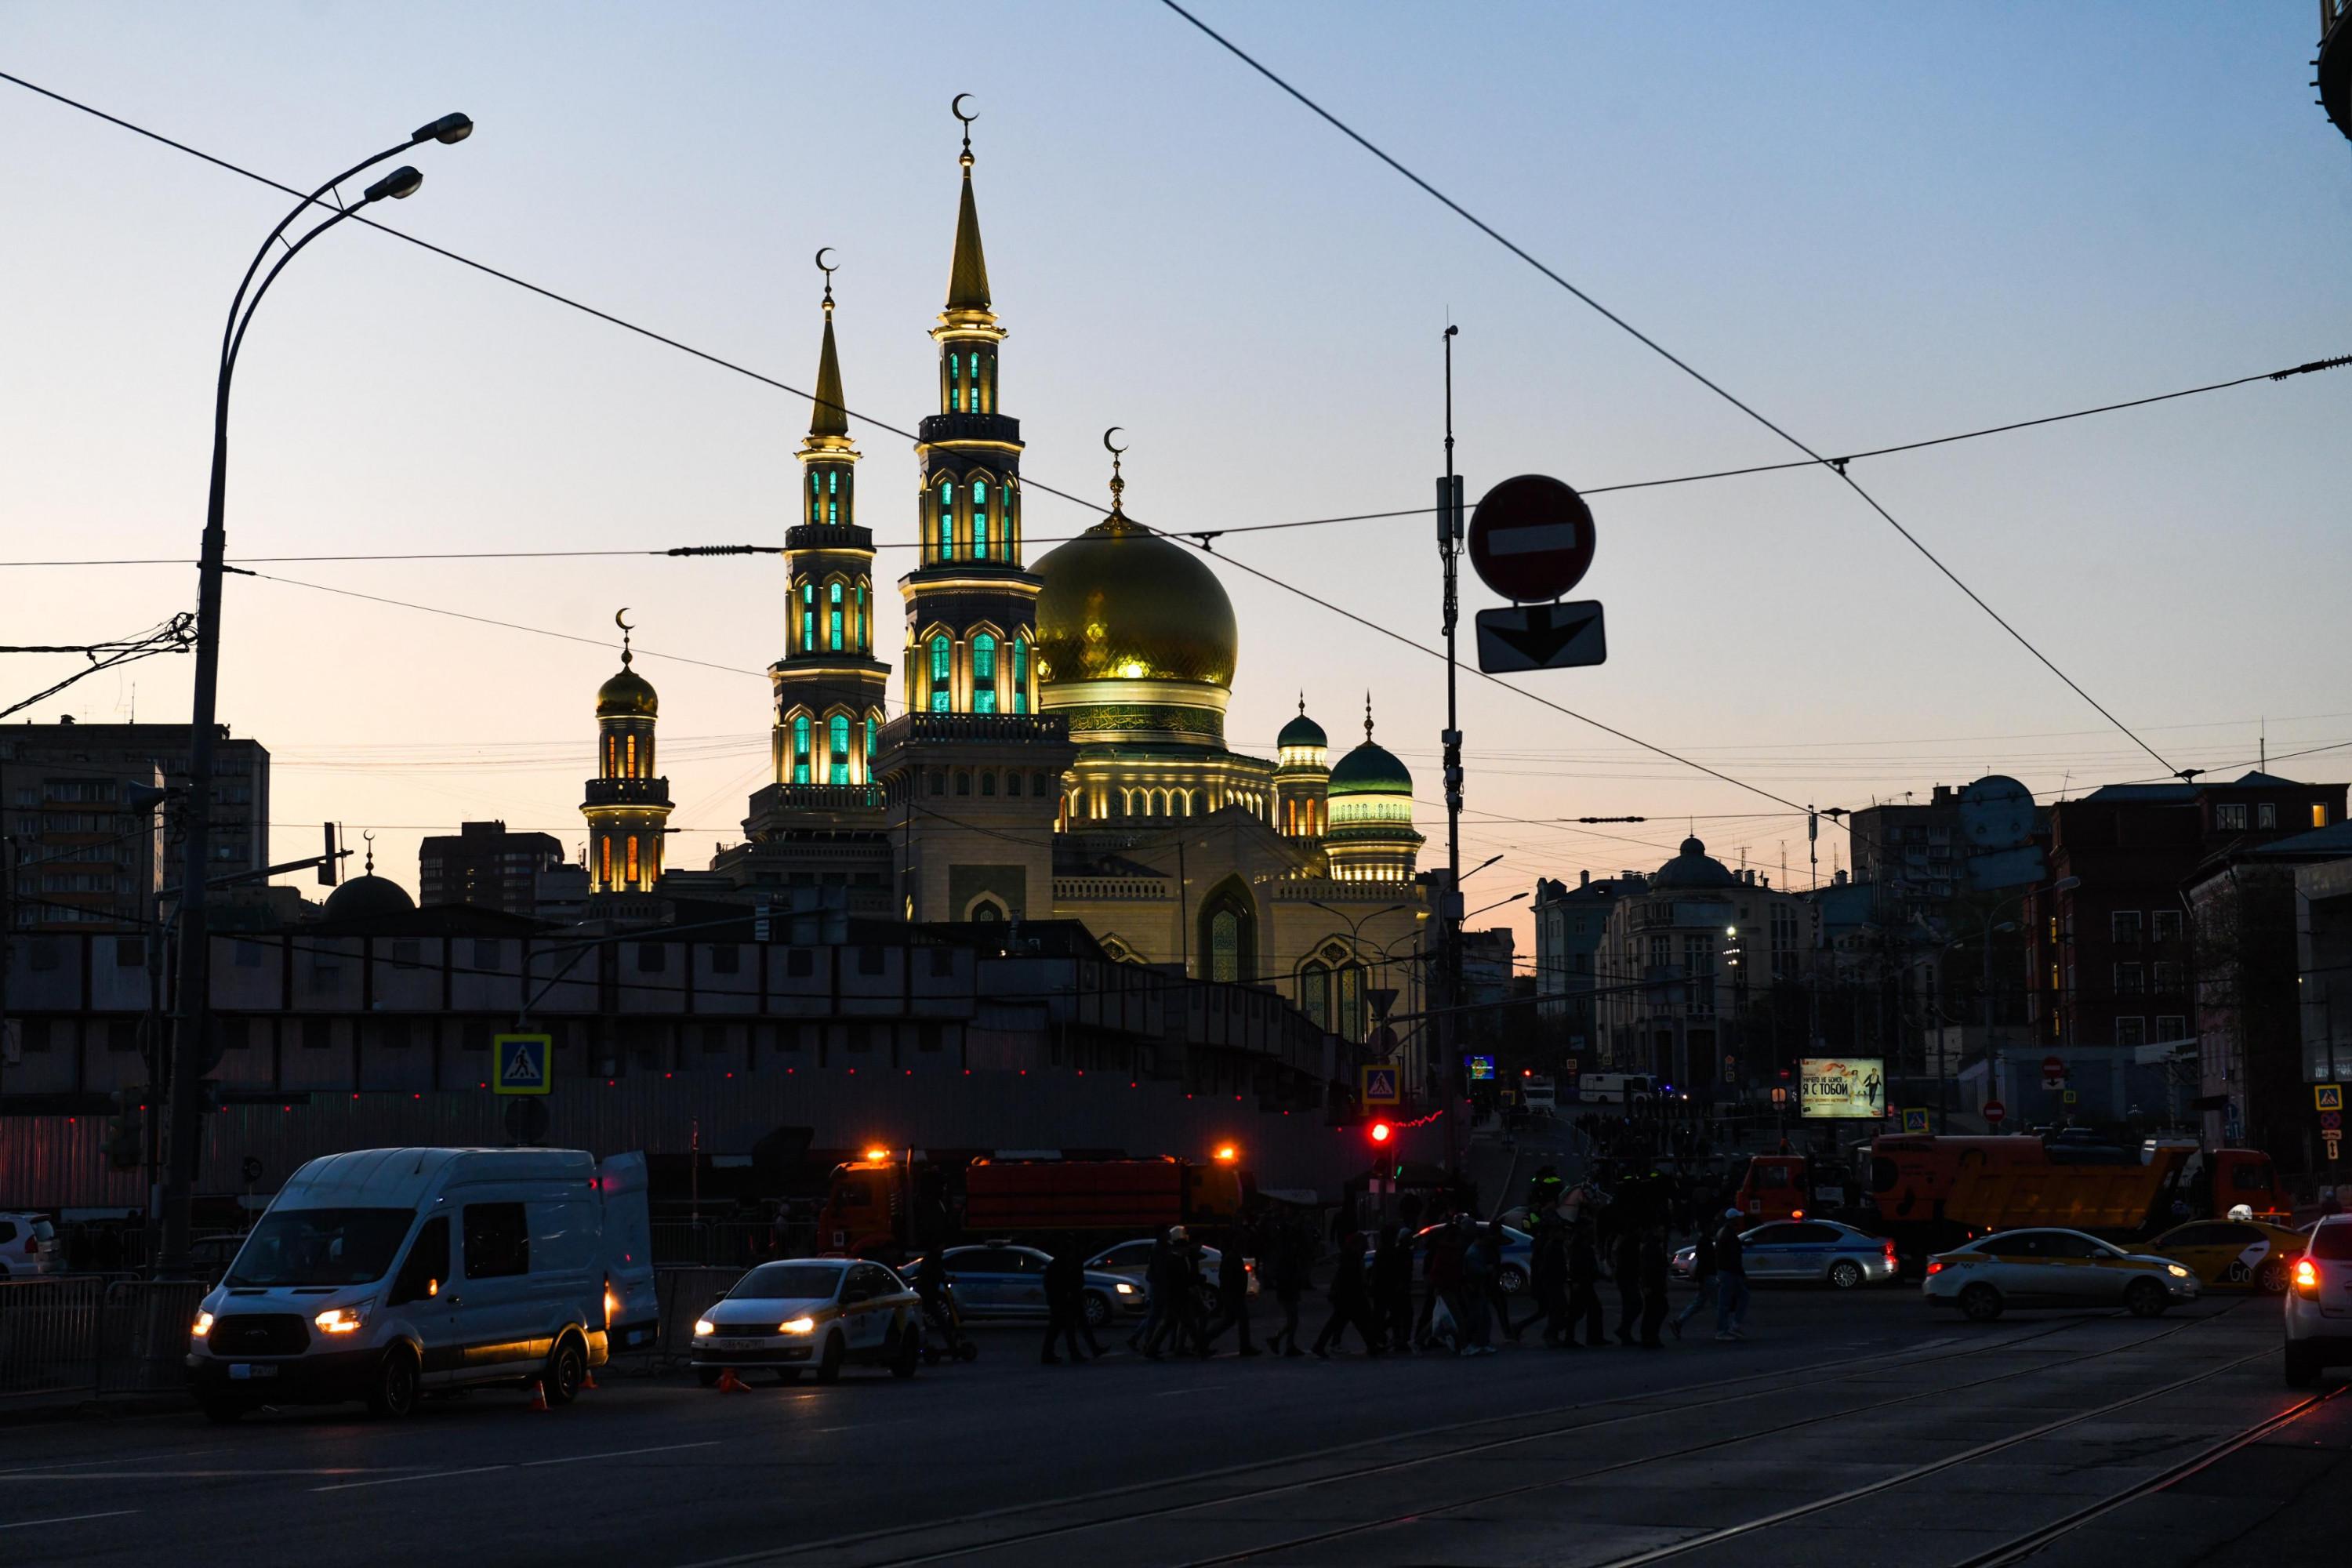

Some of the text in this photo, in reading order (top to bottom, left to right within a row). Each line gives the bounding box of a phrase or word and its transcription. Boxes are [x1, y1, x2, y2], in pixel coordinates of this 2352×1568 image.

[1803, 1083, 1809, 1095] Я
[1812, 1083, 1817, 1095] С
[2229, 1261, 2252, 1283] Go
